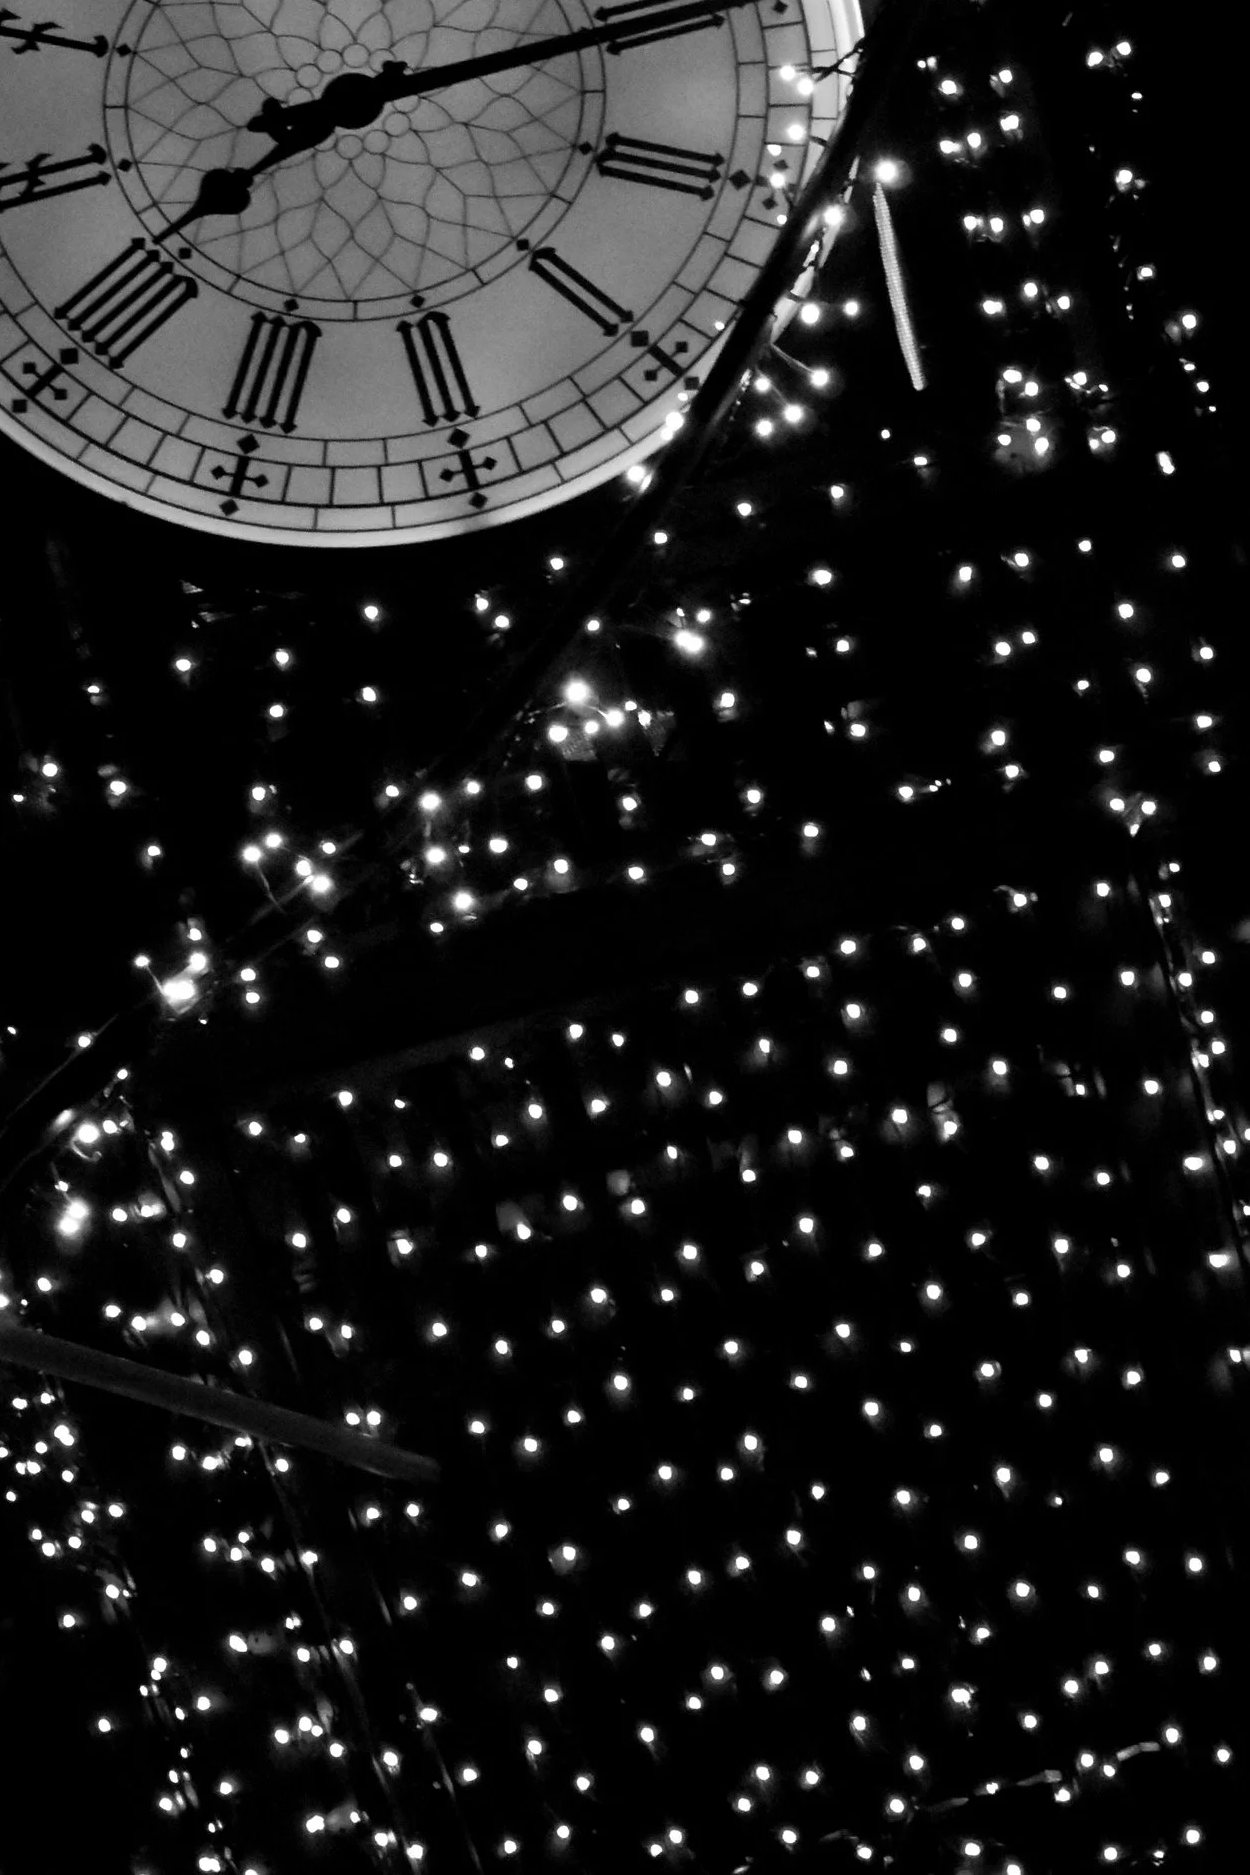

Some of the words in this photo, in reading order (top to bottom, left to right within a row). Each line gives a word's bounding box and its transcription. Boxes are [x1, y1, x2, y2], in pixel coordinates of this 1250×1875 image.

[54, 237, 198, 369] VIII
[529, 247, 634, 337] V
[222, 311, 322, 434] VII
[396, 311, 480, 426] VI
